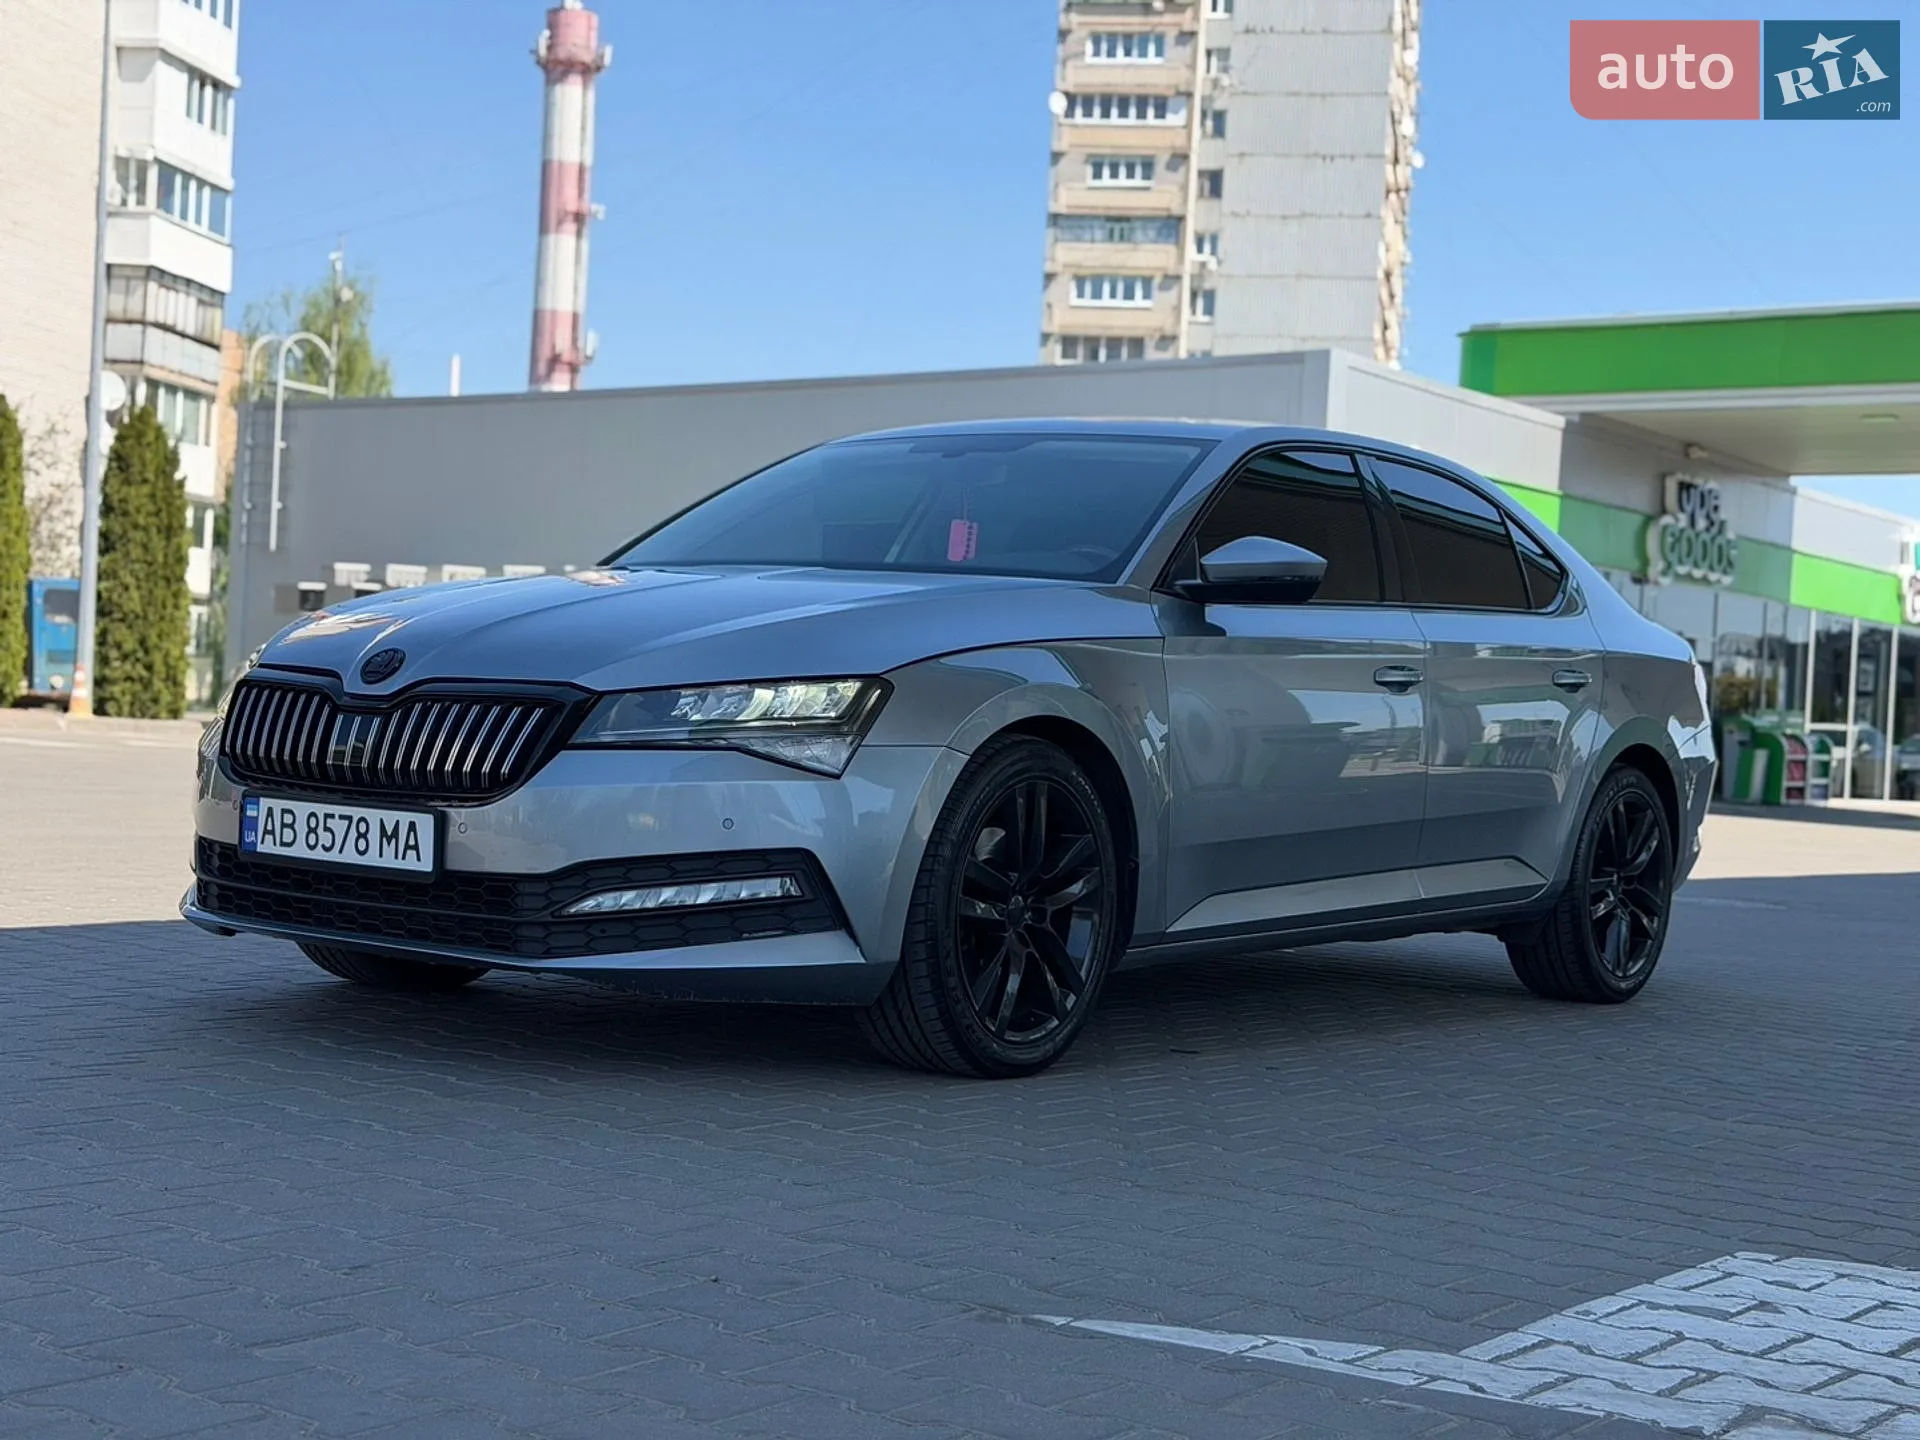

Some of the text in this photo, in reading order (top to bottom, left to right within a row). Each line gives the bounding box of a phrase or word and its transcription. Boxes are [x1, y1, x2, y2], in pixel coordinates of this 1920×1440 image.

[244, 830, 257, 843] UA
[260, 806, 422, 862] AB 8578 MA
